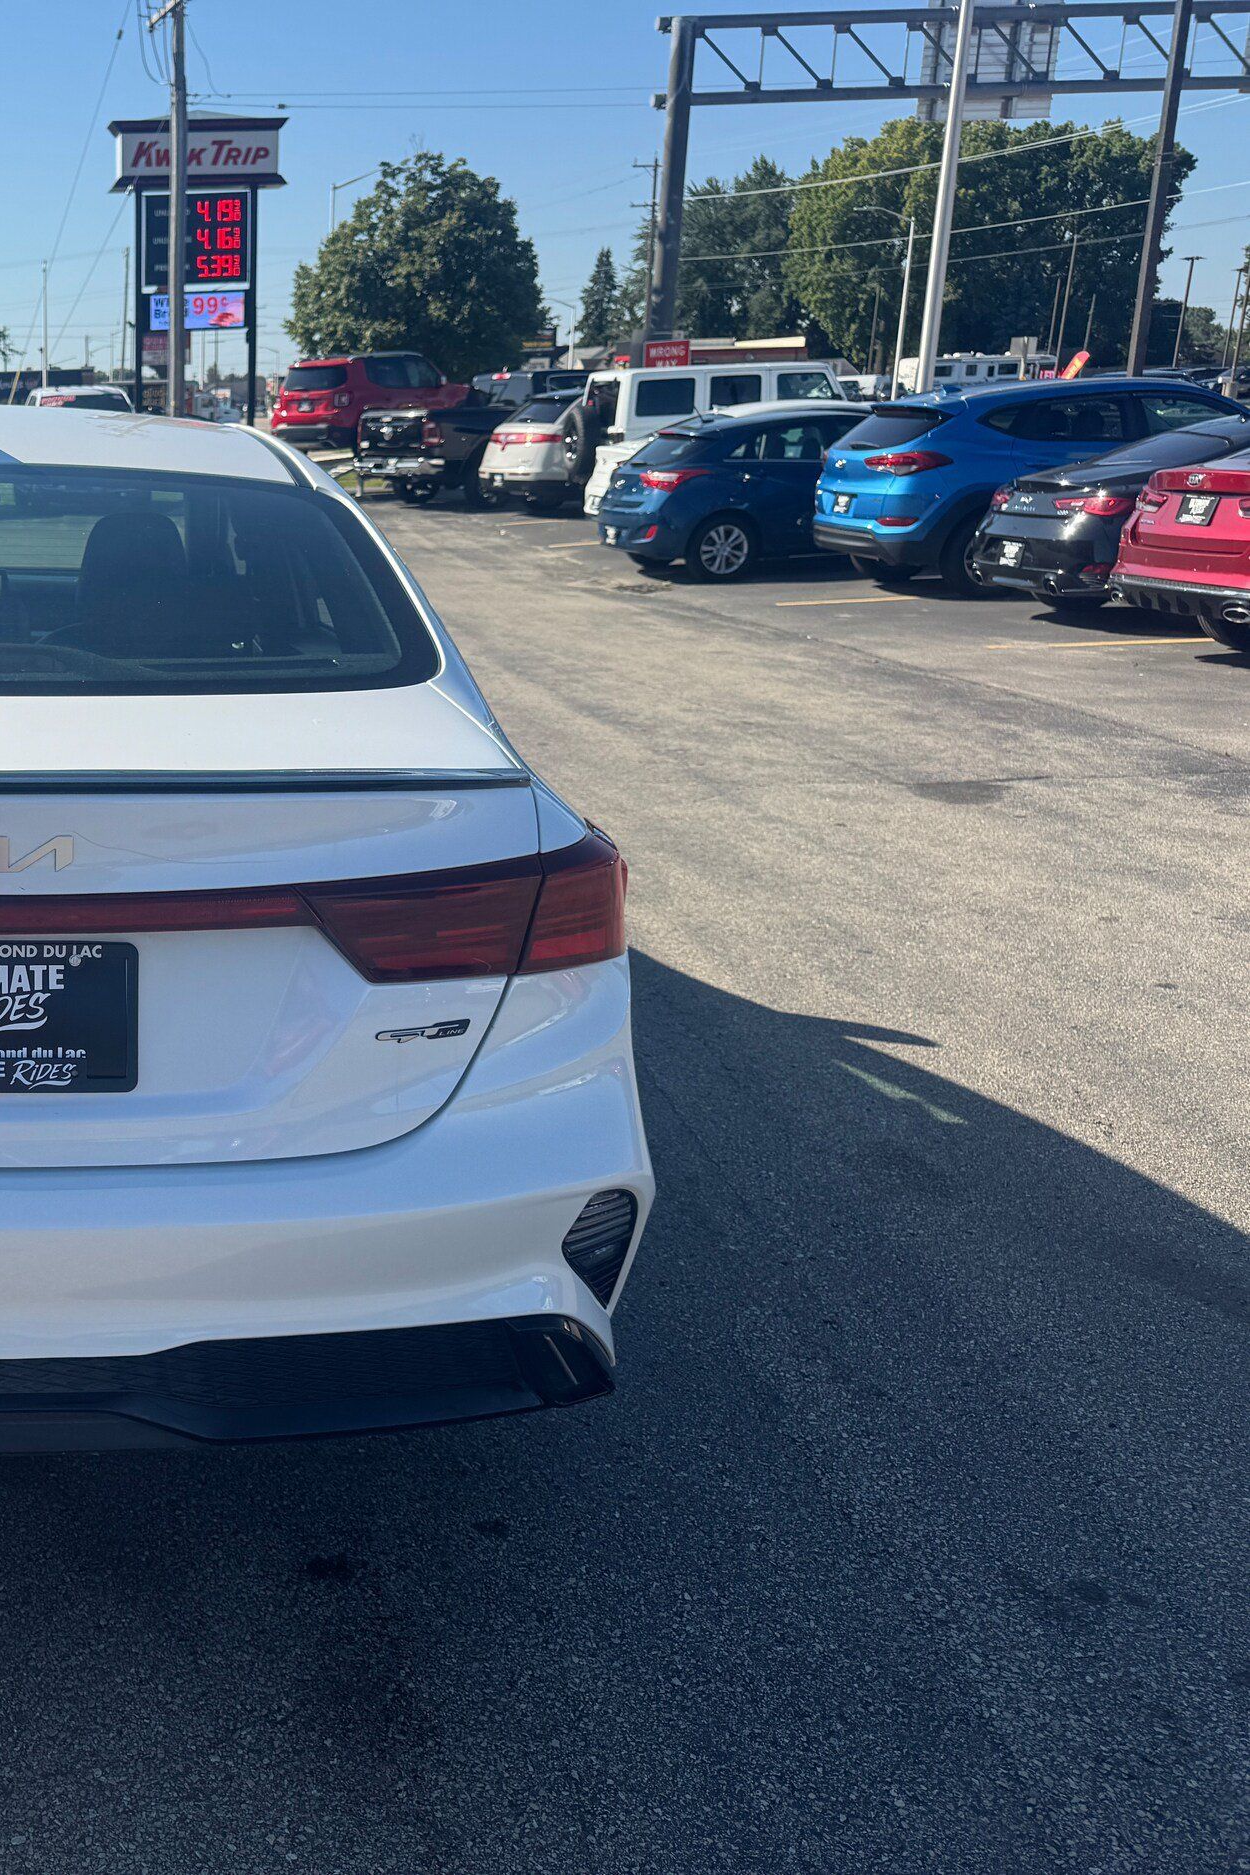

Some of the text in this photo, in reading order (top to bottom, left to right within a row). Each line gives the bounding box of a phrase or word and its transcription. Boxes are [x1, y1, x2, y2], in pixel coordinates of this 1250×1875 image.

[132, 140, 270, 168] KWK TRIP
[649, 345, 686, 358] WRONG
[43, 944, 67, 959] DU
